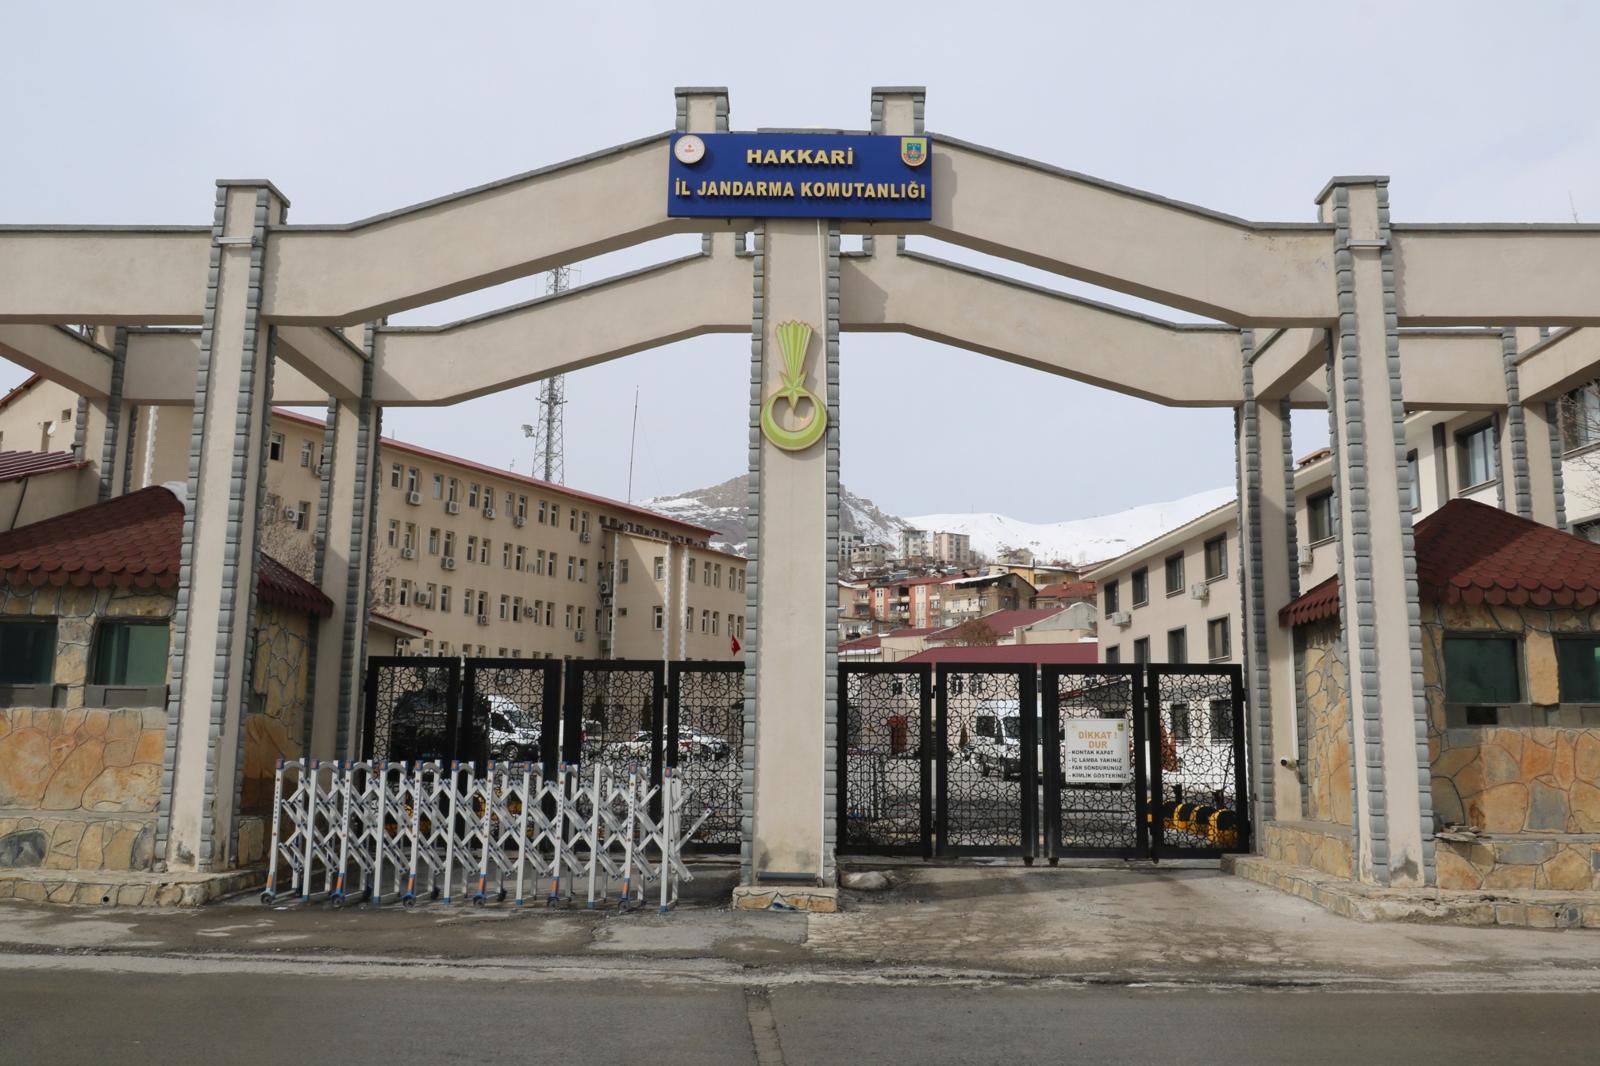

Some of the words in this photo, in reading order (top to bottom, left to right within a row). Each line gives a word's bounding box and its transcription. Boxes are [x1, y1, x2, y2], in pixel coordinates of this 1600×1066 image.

[747, 148, 853, 165] HAKKARİ
[675, 178, 690, 196] İL
[697, 180, 794, 197] JANDARMA
[801, 180, 926, 198] KOMUTANLIĞI
[1078, 730, 1112, 739] DİKKAT
[1088, 740, 1108, 749] DUR
